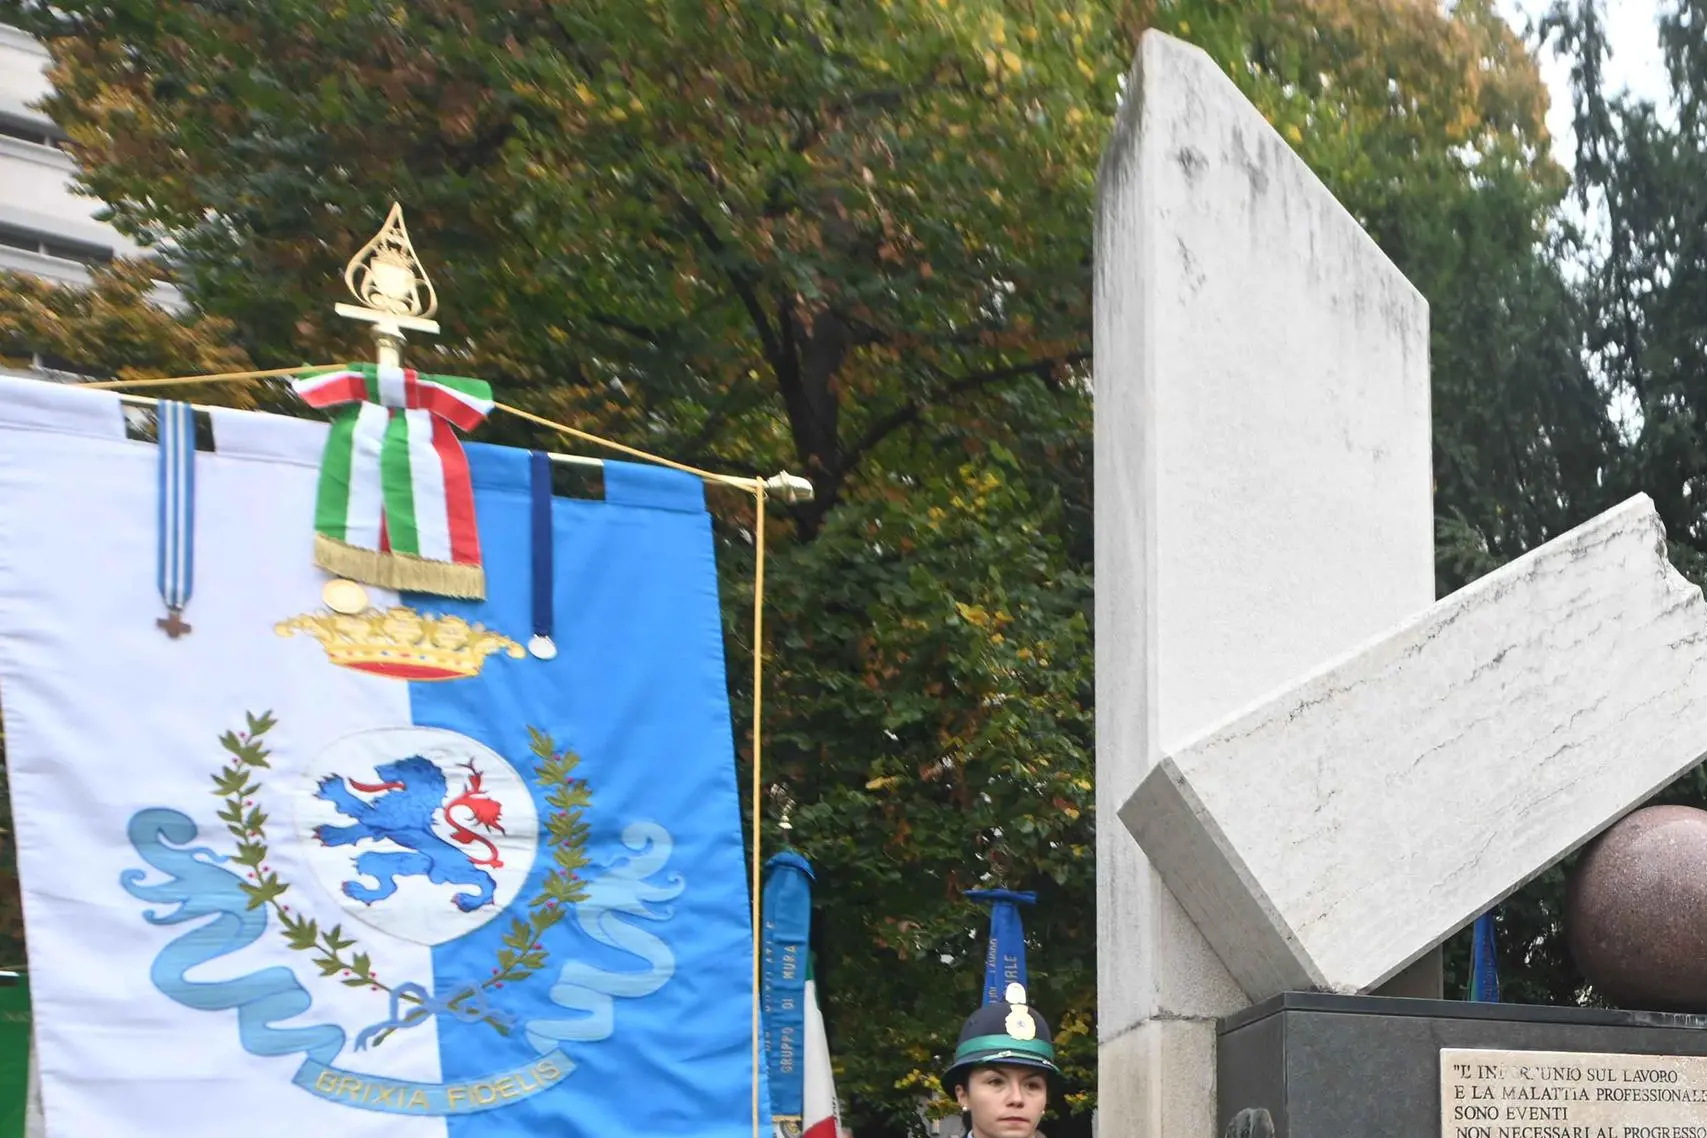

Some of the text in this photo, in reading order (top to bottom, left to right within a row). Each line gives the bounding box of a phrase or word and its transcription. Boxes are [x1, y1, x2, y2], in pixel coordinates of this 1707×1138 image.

[1478, 1064, 1582, 1081] INRUNIO
[1587, 1068, 1617, 1082] SUL
[1623, 1069, 1678, 1083] LAVORO
[315, 1061, 562, 1110] BRIXIA FIDELIS
[1454, 1084, 1465, 1099] E
[1472, 1085, 1495, 1100] LA
[1502, 1086, 1590, 1101] MALATTIA
[1454, 1105, 1568, 1121] SONO EVENTI
